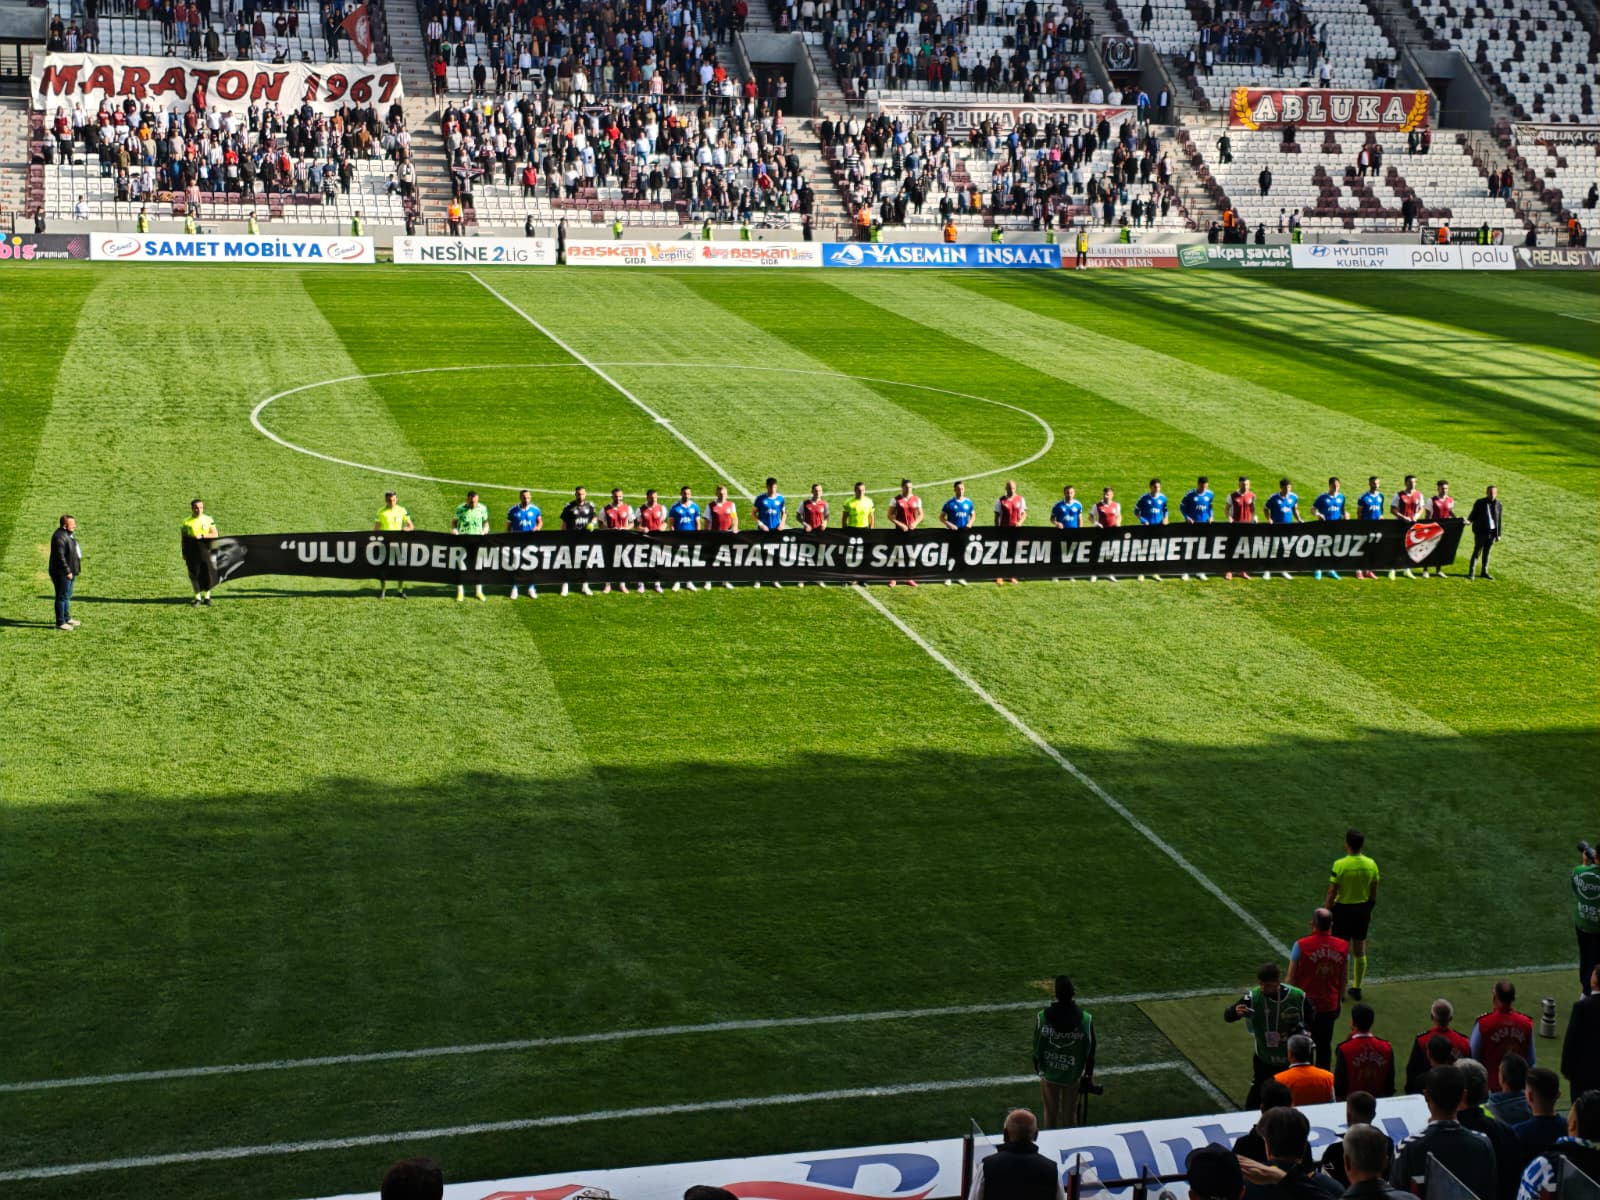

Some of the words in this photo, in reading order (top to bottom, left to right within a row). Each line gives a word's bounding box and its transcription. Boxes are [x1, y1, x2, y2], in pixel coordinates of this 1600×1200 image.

[39, 65, 290, 101] MARATON
[302, 72, 399, 103] 1967
[1252, 94, 1407, 123] ABLUKA
[145, 240, 220, 257] SAMET
[224, 238, 323, 258] MOBİLYA
[1207, 245, 1244, 260] akpa
[1333, 247, 1389, 257] HYUNDAI
[1411, 248, 1449, 267] palu
[1471, 247, 1509, 267] palu
[1532, 249, 1587, 266] REALIST
[365, 536, 468, 571] ÖNDER
[474, 543, 606, 572] MUSTAFA
[612, 543, 706, 569] KEMAL
[870, 542, 956, 571] SAYGI,
[964, 534, 1051, 566] ÖZLEM
[1060, 540, 1093, 564] VE
[1097, 533, 1228, 563] MİNNETLE
